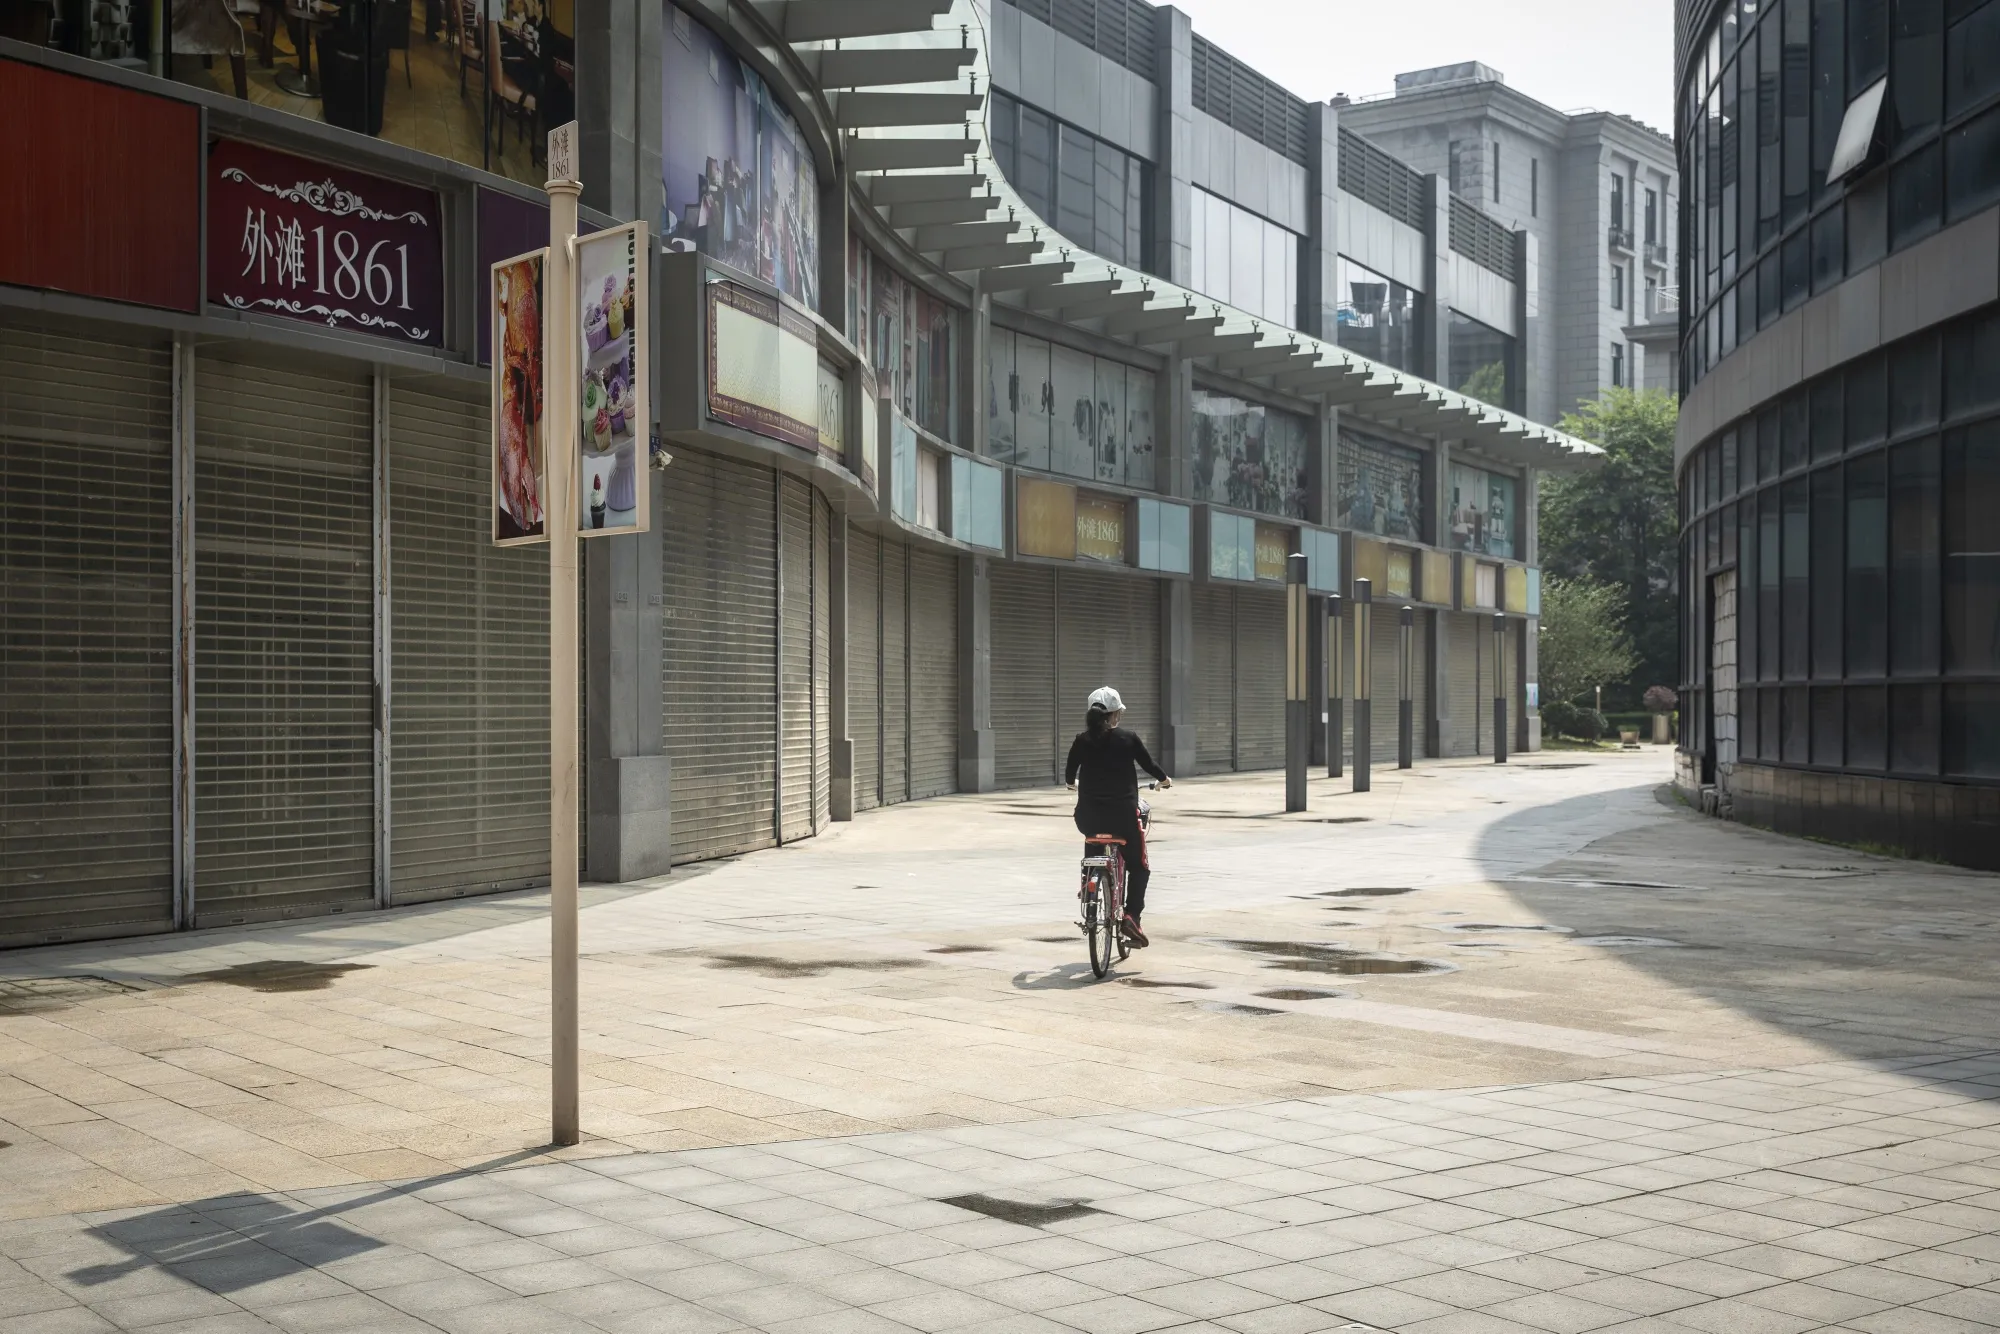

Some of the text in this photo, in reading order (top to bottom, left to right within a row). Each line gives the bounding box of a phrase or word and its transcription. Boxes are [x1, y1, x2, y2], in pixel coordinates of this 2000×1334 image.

[552, 158, 570, 180] 1861
[241, 206, 413, 311] 外滩1861
[819, 383, 840, 443] 1861
